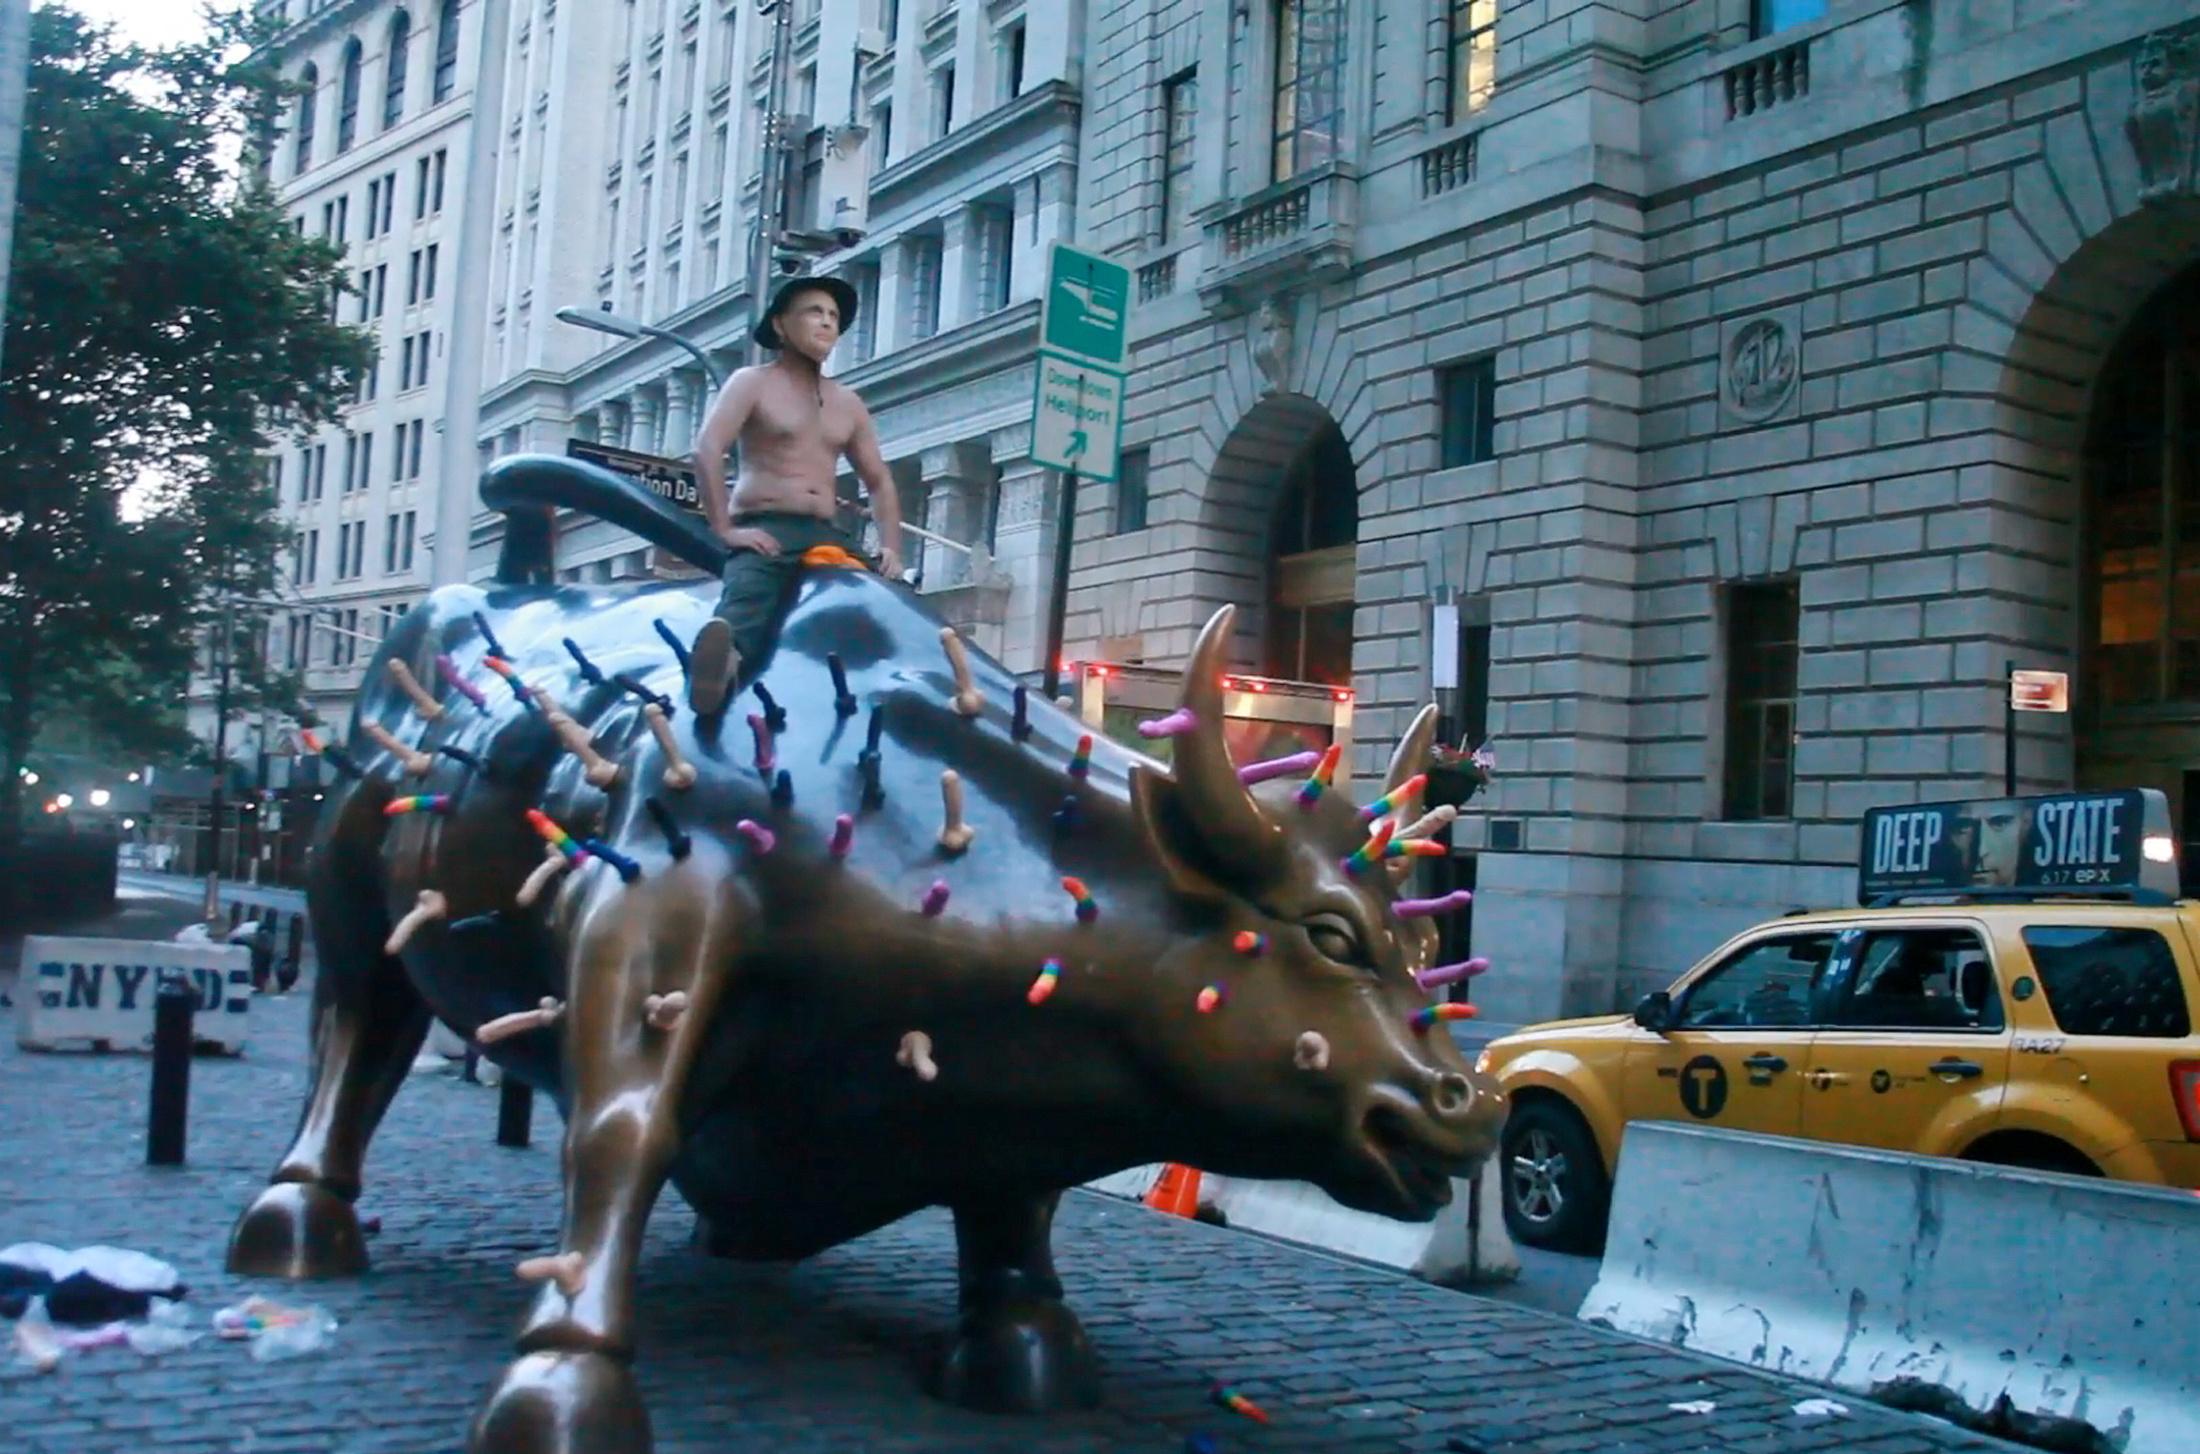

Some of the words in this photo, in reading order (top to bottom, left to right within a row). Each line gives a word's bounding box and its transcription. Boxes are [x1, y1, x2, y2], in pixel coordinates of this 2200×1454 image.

[1872, 811, 1943, 875] DEEP
[2034, 798, 2124, 867] STATE
[1690, 1067, 1717, 1112] T
